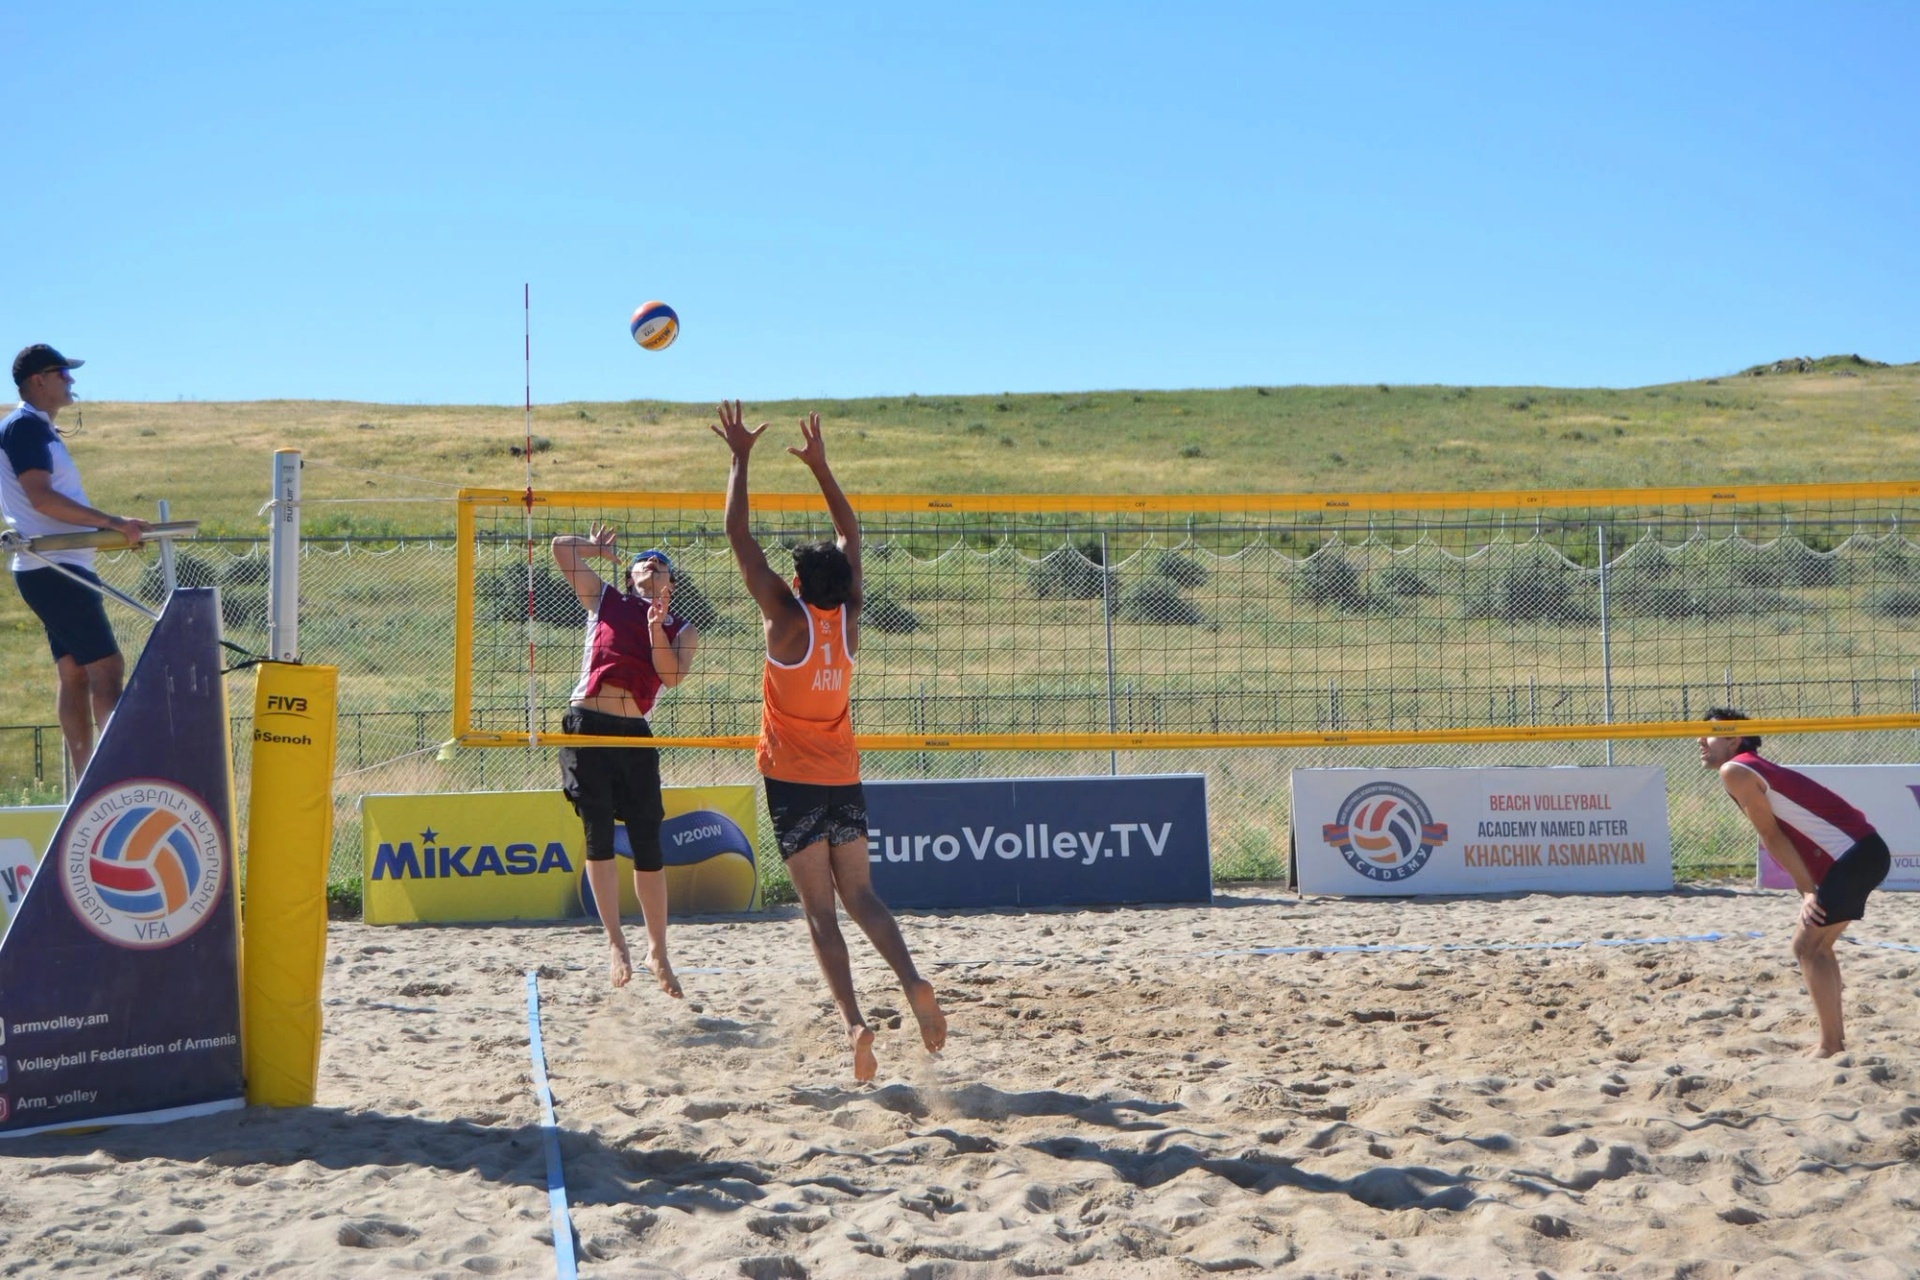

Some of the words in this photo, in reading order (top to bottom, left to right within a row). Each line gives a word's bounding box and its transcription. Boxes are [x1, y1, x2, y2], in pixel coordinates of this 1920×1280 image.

[820, 642, 832, 666] 1
[811, 668, 843, 691] ARM
[267, 695, 307, 711] FIVB
[262, 731, 312, 745] Senoh
[1489, 795, 1531, 811] BEACH
[1533, 794, 1612, 811] VOLLEYBALL
[672, 823, 723, 847] V200W
[1478, 821, 1538, 838] ACADEMY
[1540, 820, 1586, 837] NAMED
[1588, 820, 1628, 836] AFTER
[868, 821, 1173, 865] EuroVolley.TV
[1344, 848, 1427, 879] ACADEMY
[1464, 844, 1543, 867] KHACHIK
[1547, 842, 1646, 866] ASMARYAN
[134, 921, 171, 940] VFA
[13, 1012, 109, 1034] armvolley.am
[17, 1052, 87, 1072] Volleyball
[91, 1042, 165, 1062] Federation
[168, 1038, 182, 1052] of
[184, 1033, 237, 1051] Armenia
[16, 1089, 98, 1110] Arm_volley
